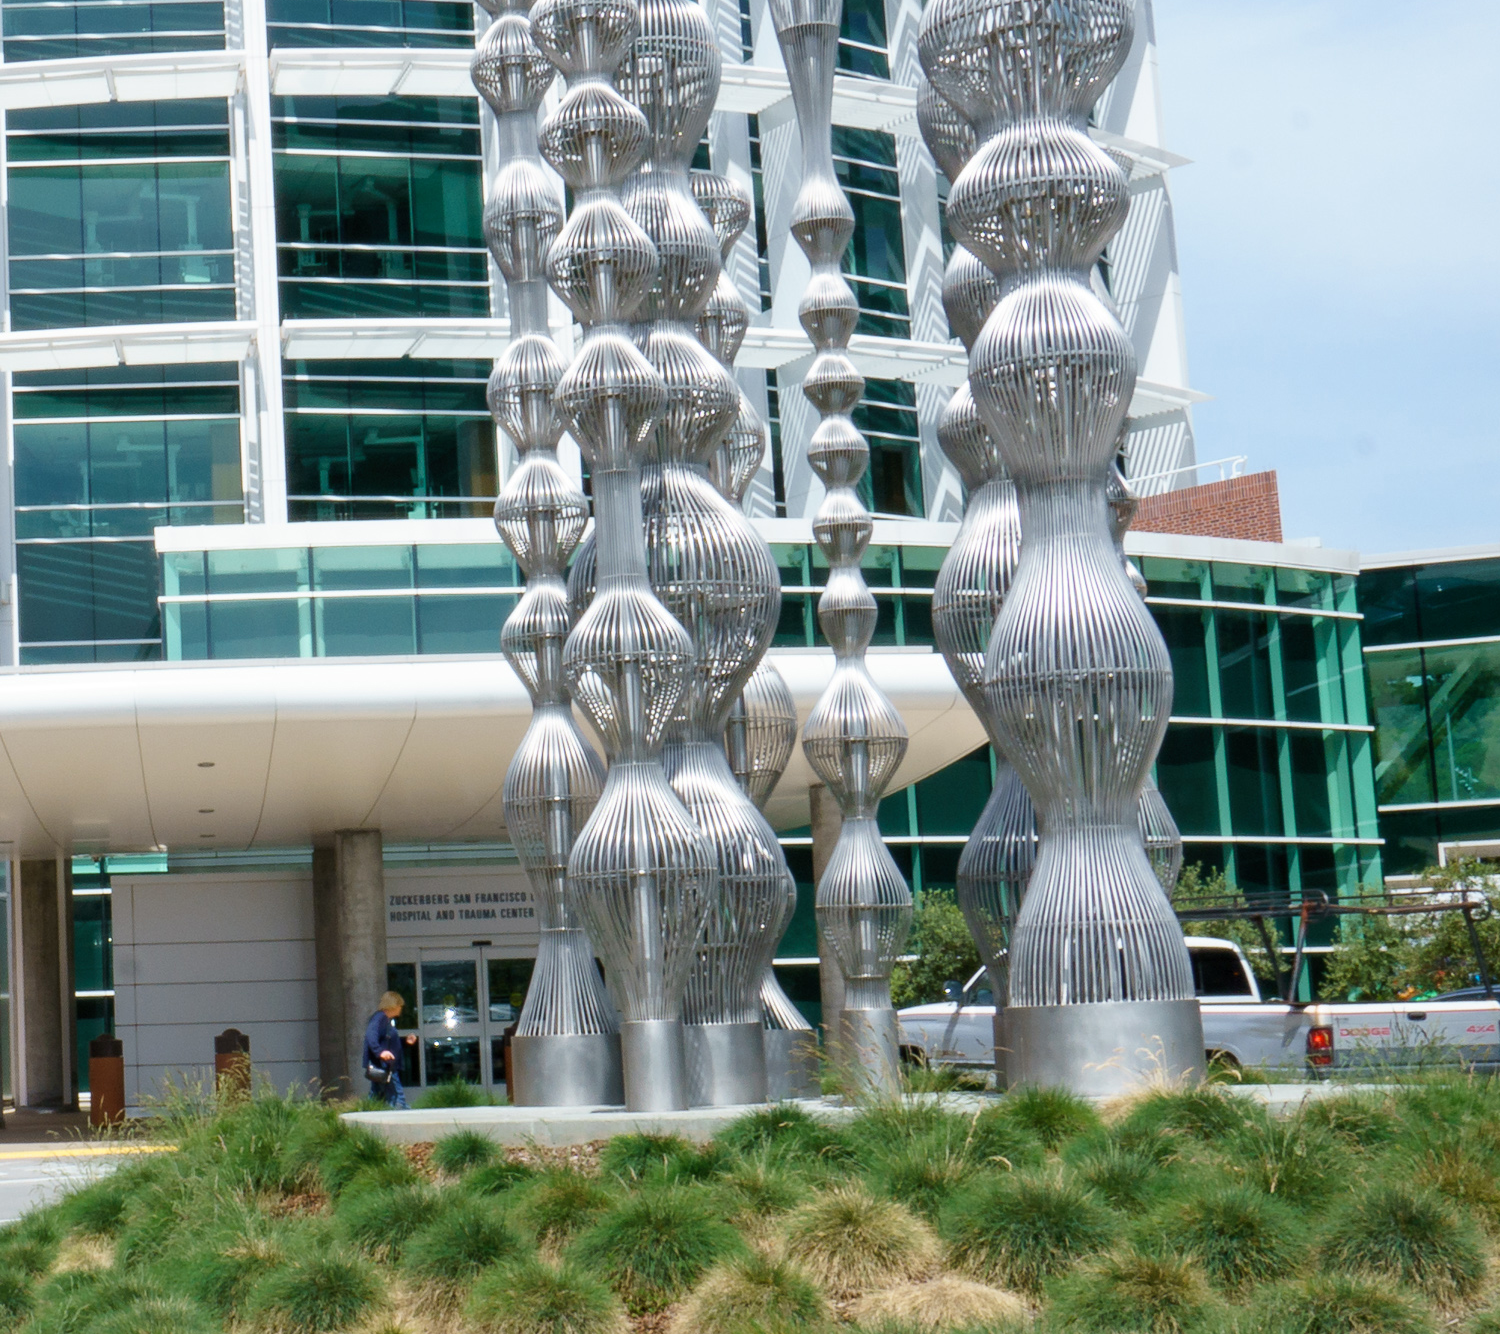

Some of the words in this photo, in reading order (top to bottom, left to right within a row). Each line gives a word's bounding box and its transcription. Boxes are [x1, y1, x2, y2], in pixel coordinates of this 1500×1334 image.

[389, 894, 450, 906] ZUCKERBERG
[453, 893, 471, 904] SAN
[475, 892, 527, 904] FRANCISCO
[390, 910, 431, 922] HOSPITAL
[436, 910, 455, 921] AND
[459, 909, 497, 920] TRAUMA
[500, 907, 535, 919] CENTER
[1339, 1027, 1391, 1037] DODGE
